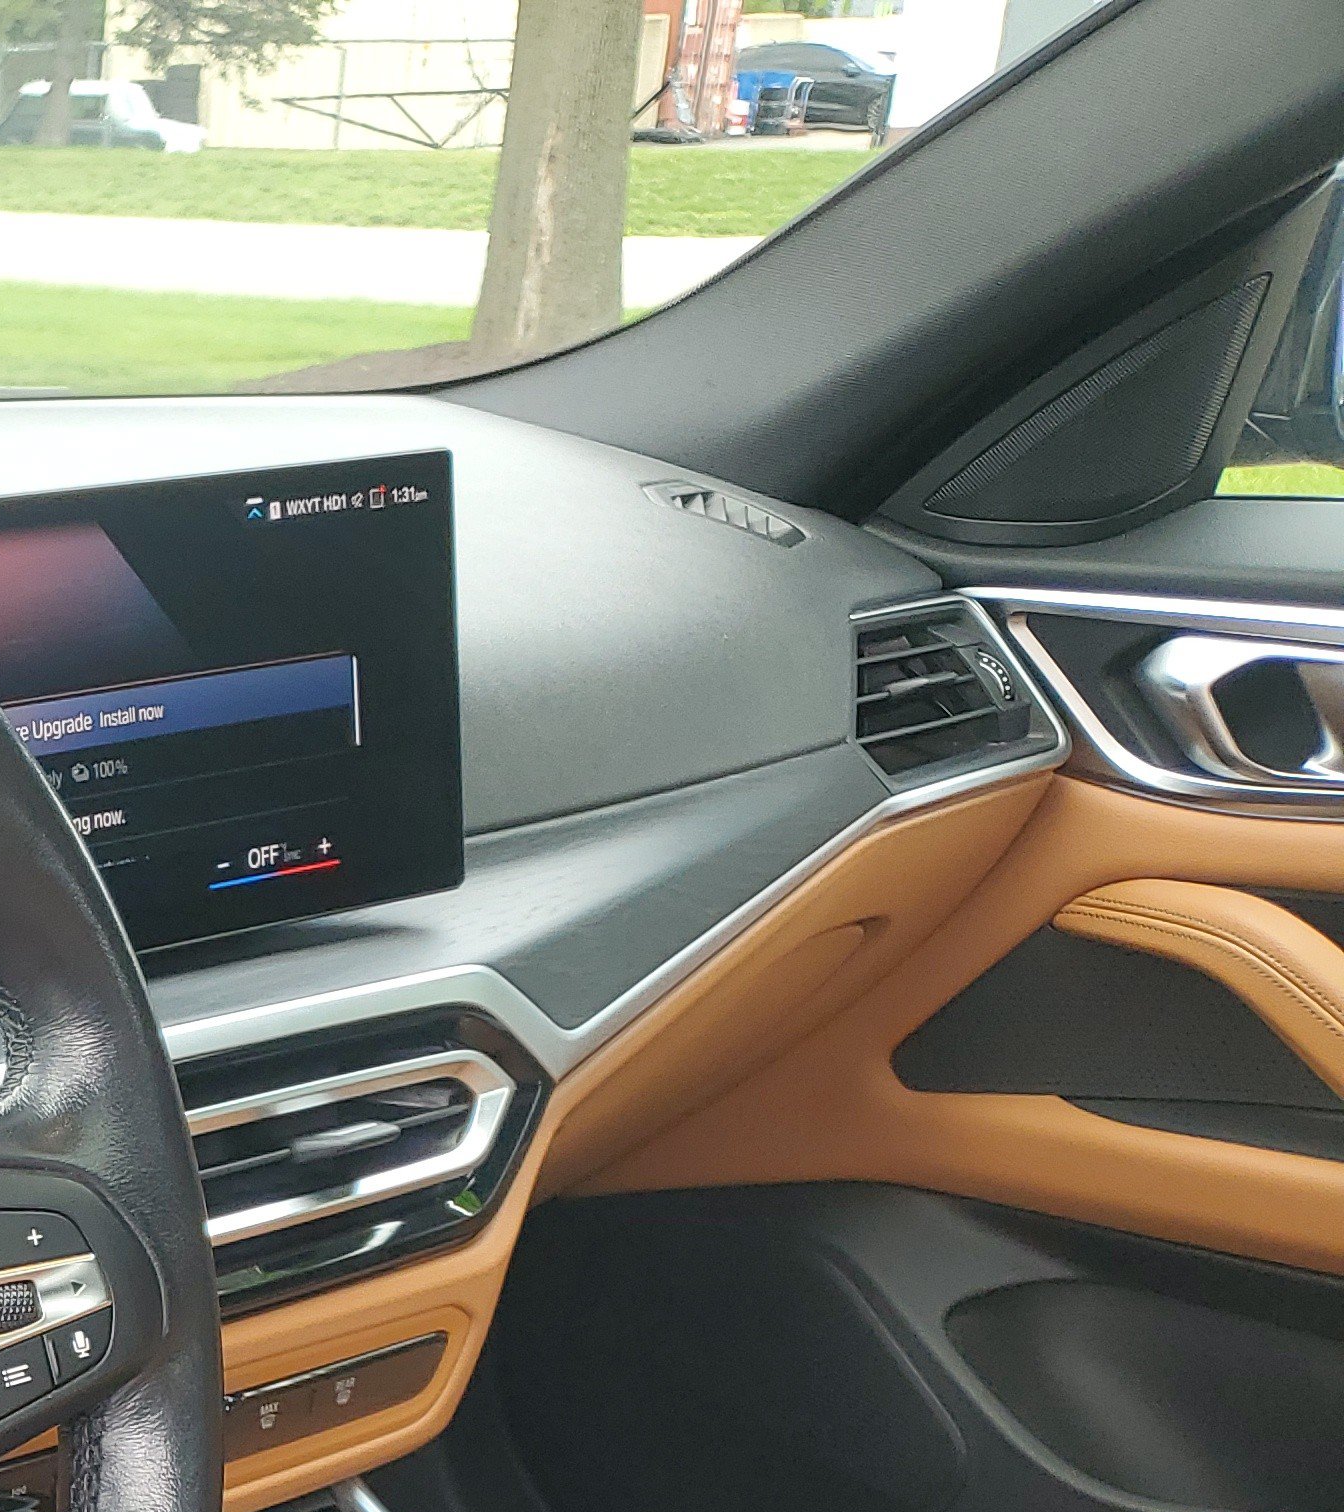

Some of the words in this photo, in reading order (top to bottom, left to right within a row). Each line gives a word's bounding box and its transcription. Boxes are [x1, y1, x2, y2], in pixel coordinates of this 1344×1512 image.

[286, 498, 321, 516] WXYT
[324, 494, 347, 512] HD1
[392, 485, 416, 503] 1:31
[32, 713, 93, 742] Upgrade
[99, 706, 136, 728] Install
[139, 705, 164, 721] now
[92, 758, 128, 780] 100%
[93, 809, 127, 829] now.
[248, 844, 279, 869] OFF
